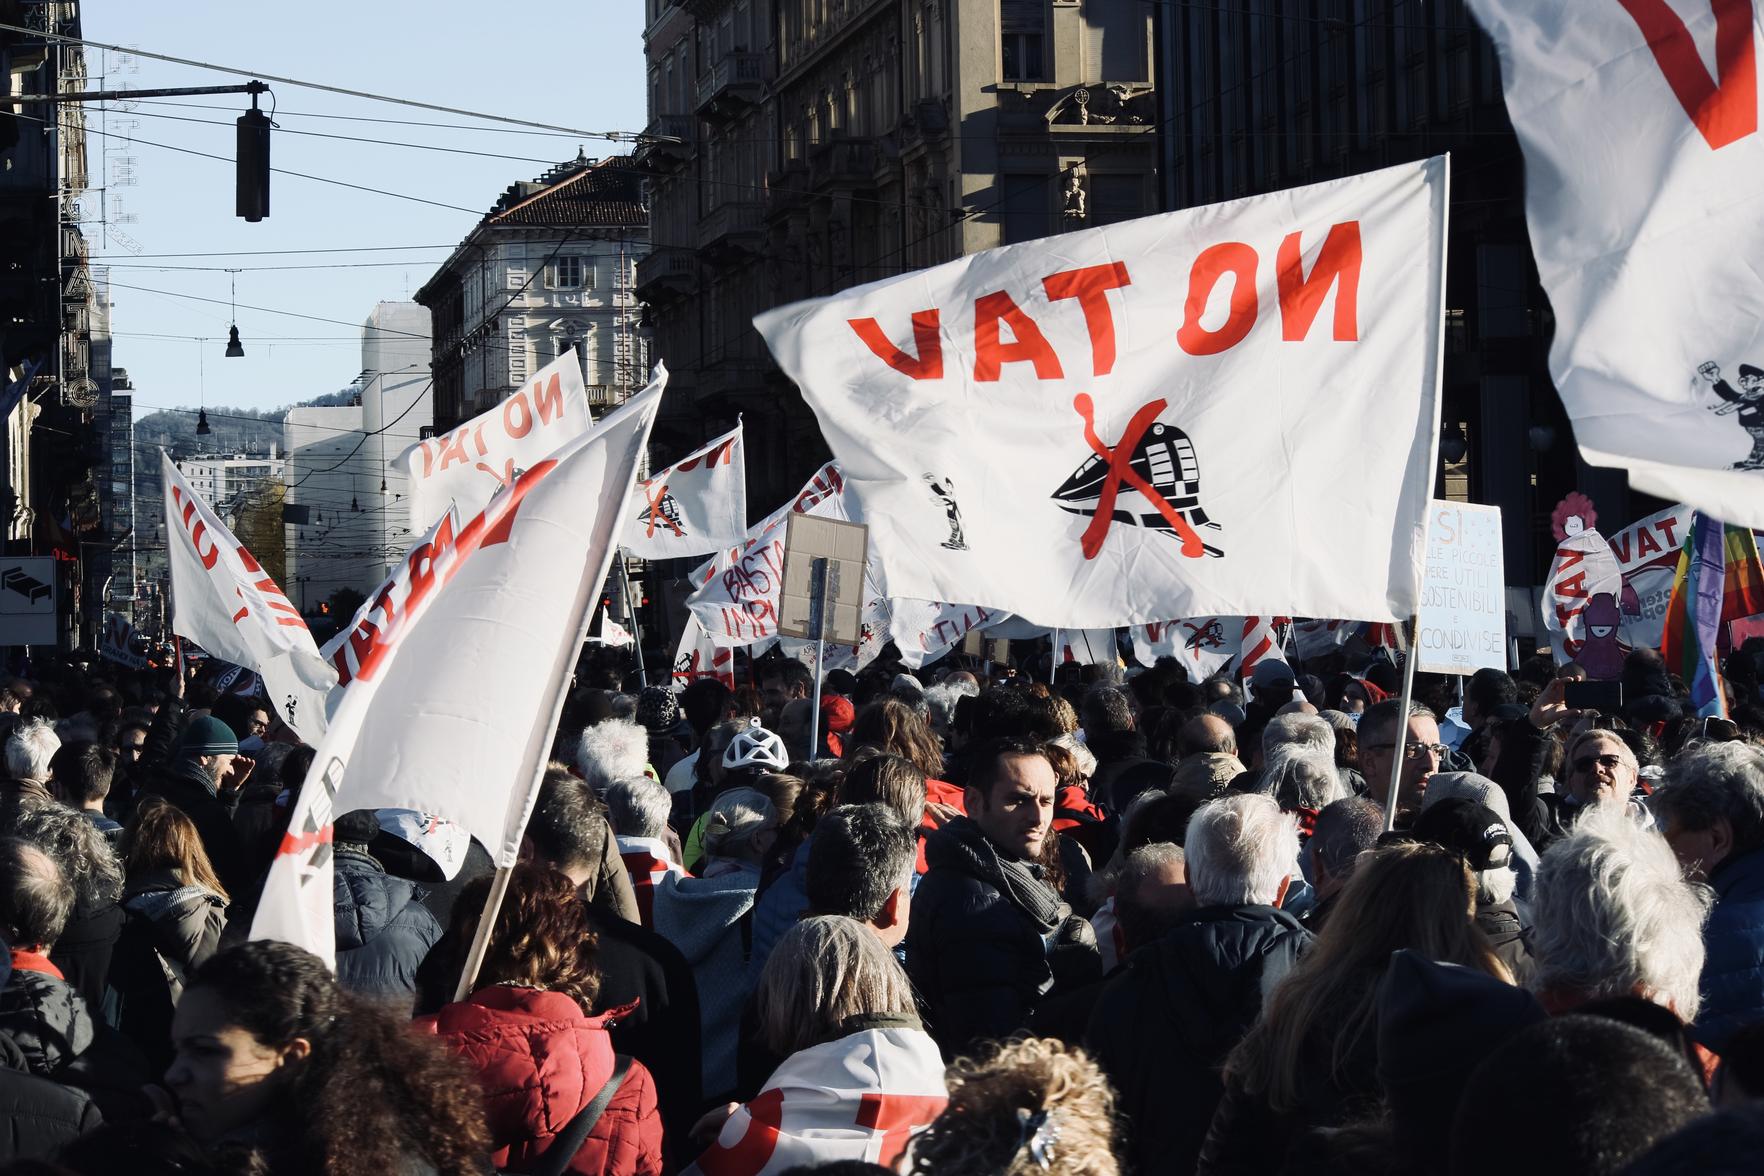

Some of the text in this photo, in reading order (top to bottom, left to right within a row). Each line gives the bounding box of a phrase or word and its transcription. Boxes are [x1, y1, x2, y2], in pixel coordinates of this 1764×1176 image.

[1453, 549, 1497, 568] PICCOLE
[1455, 568, 1490, 589] UTILI
[1554, 548, 1590, 629] TAV
[1421, 628, 1502, 654] CONDIVISE
